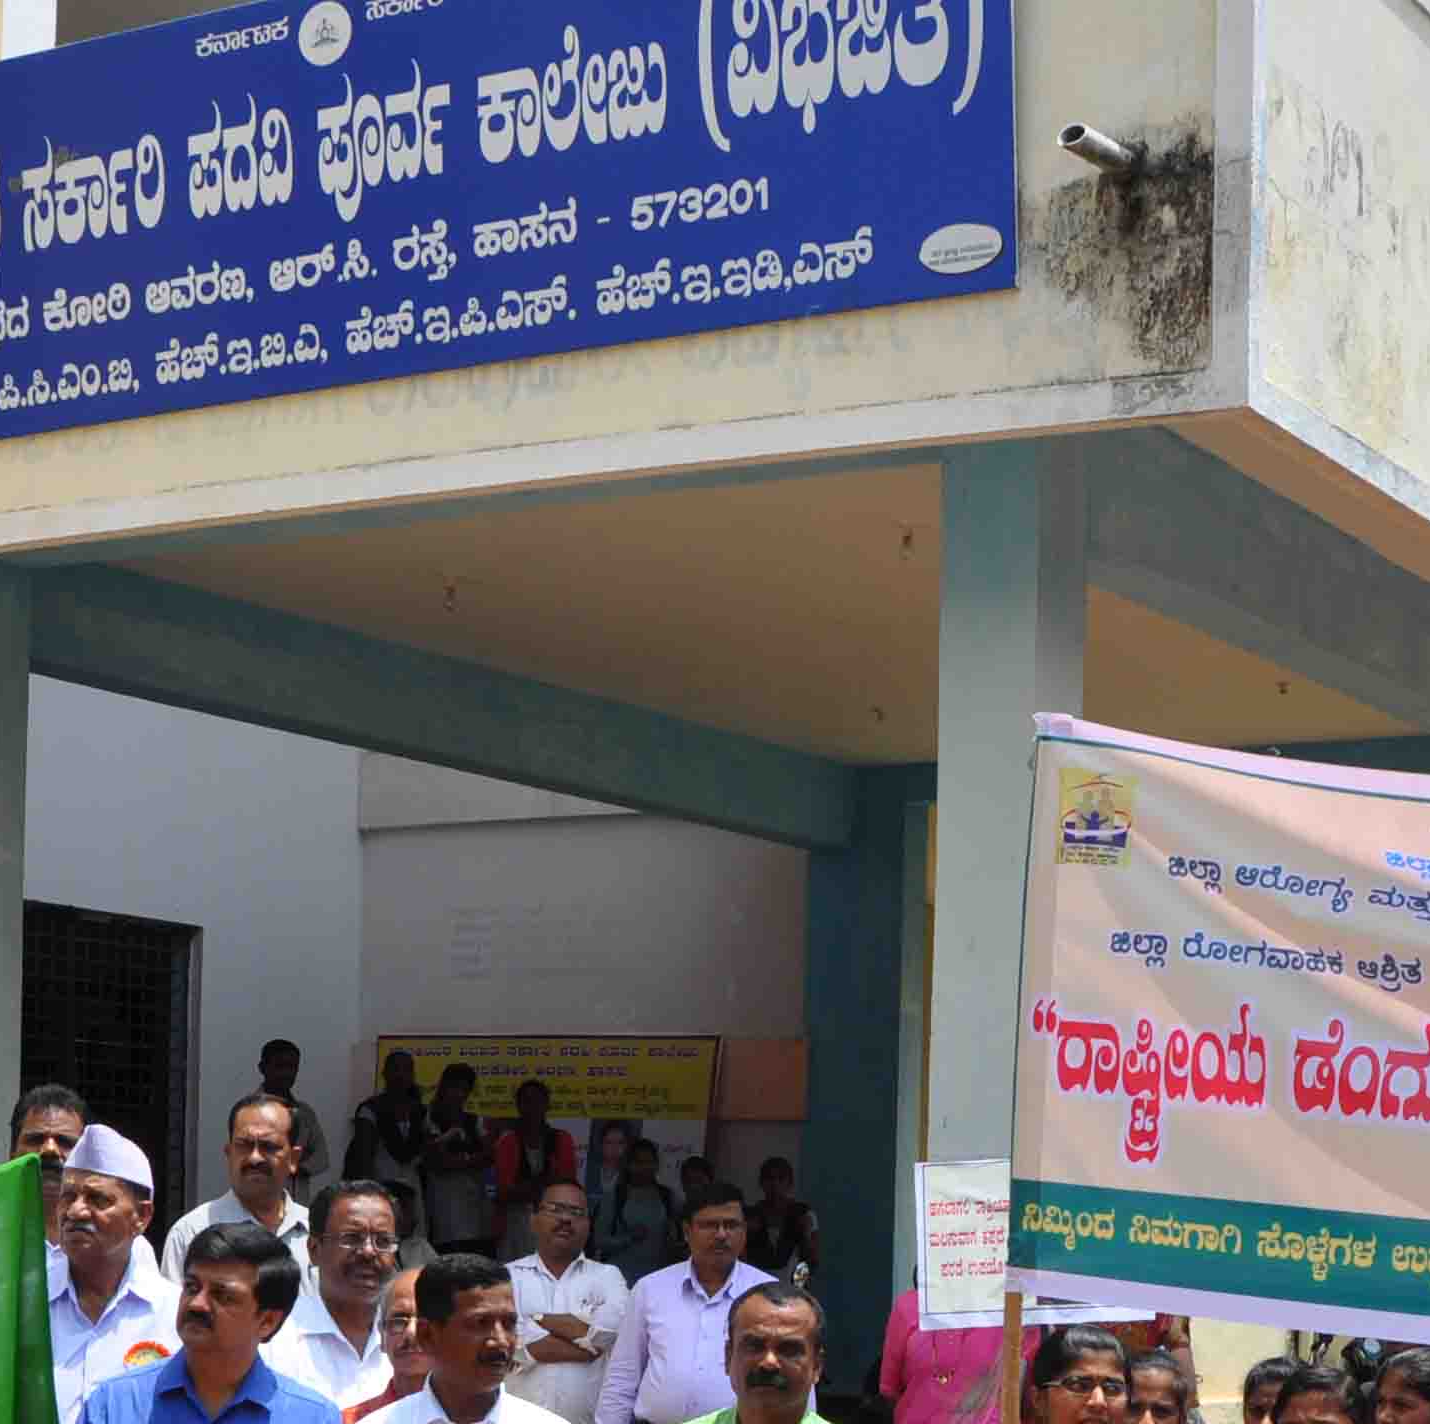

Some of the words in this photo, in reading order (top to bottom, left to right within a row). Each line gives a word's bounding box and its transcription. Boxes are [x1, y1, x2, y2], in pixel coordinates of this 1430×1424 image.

[195, 16, 290, 57] ಕರ್ನಾಟಕ
[21, 134, 166, 253] ಸರ್ಕಾರಿ
[187, 92, 294, 219] ಪದವಿ
[317, 57, 452, 222] ಪೂರ್ವ
[476, 24, 667, 163] ಕಾಲೇಜು
[144, 260, 255, 314] ಆವರಣ,
[473, 196, 578, 258] ಹಾಸನ
[631, 176, 770, 231] 573201
[1167, 855, 1223, 895] ಜಿಲ್ಲಾ
[1235, 862, 1355, 914] ಆರೋಗ್ಯ
[1109, 928, 1169, 969] ಜಿಲ್ಲಾ
[1182, 930, 1344, 976] ರೋಗವಾಹಕ
[1357, 953, 1423, 992] ಆಶ್ರಿತ
[1021, 1201, 1116, 1250] ನಿಮ್ಮಿಂದ
[1128, 1212, 1243, 1256] ನಿಮಗಾಗಿ
[1256, 1221, 1377, 1282] ಸೊಳ್ಳೆಗಳ
